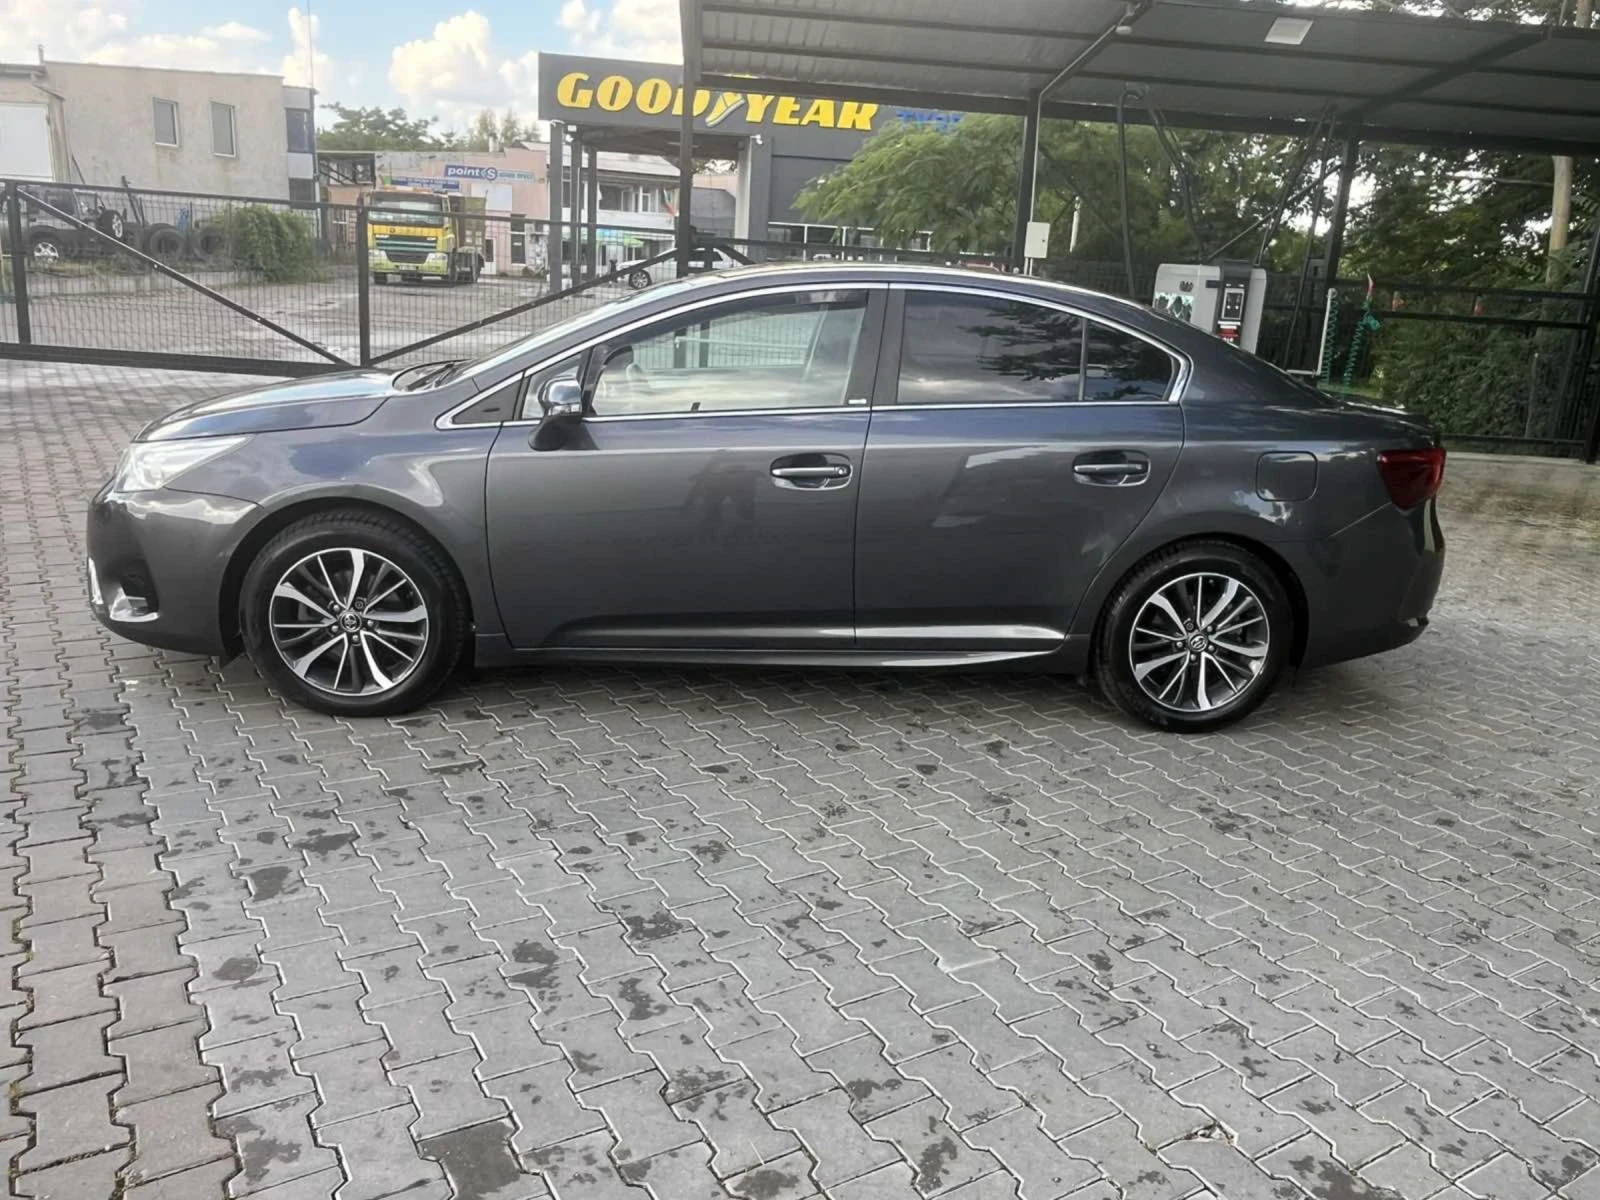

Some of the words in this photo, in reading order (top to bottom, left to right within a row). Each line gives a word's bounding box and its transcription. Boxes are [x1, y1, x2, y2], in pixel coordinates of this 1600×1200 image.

[557, 72, 879, 130] GOODYEAR
[447, 165, 480, 178] point
[486, 168, 496, 179] S
